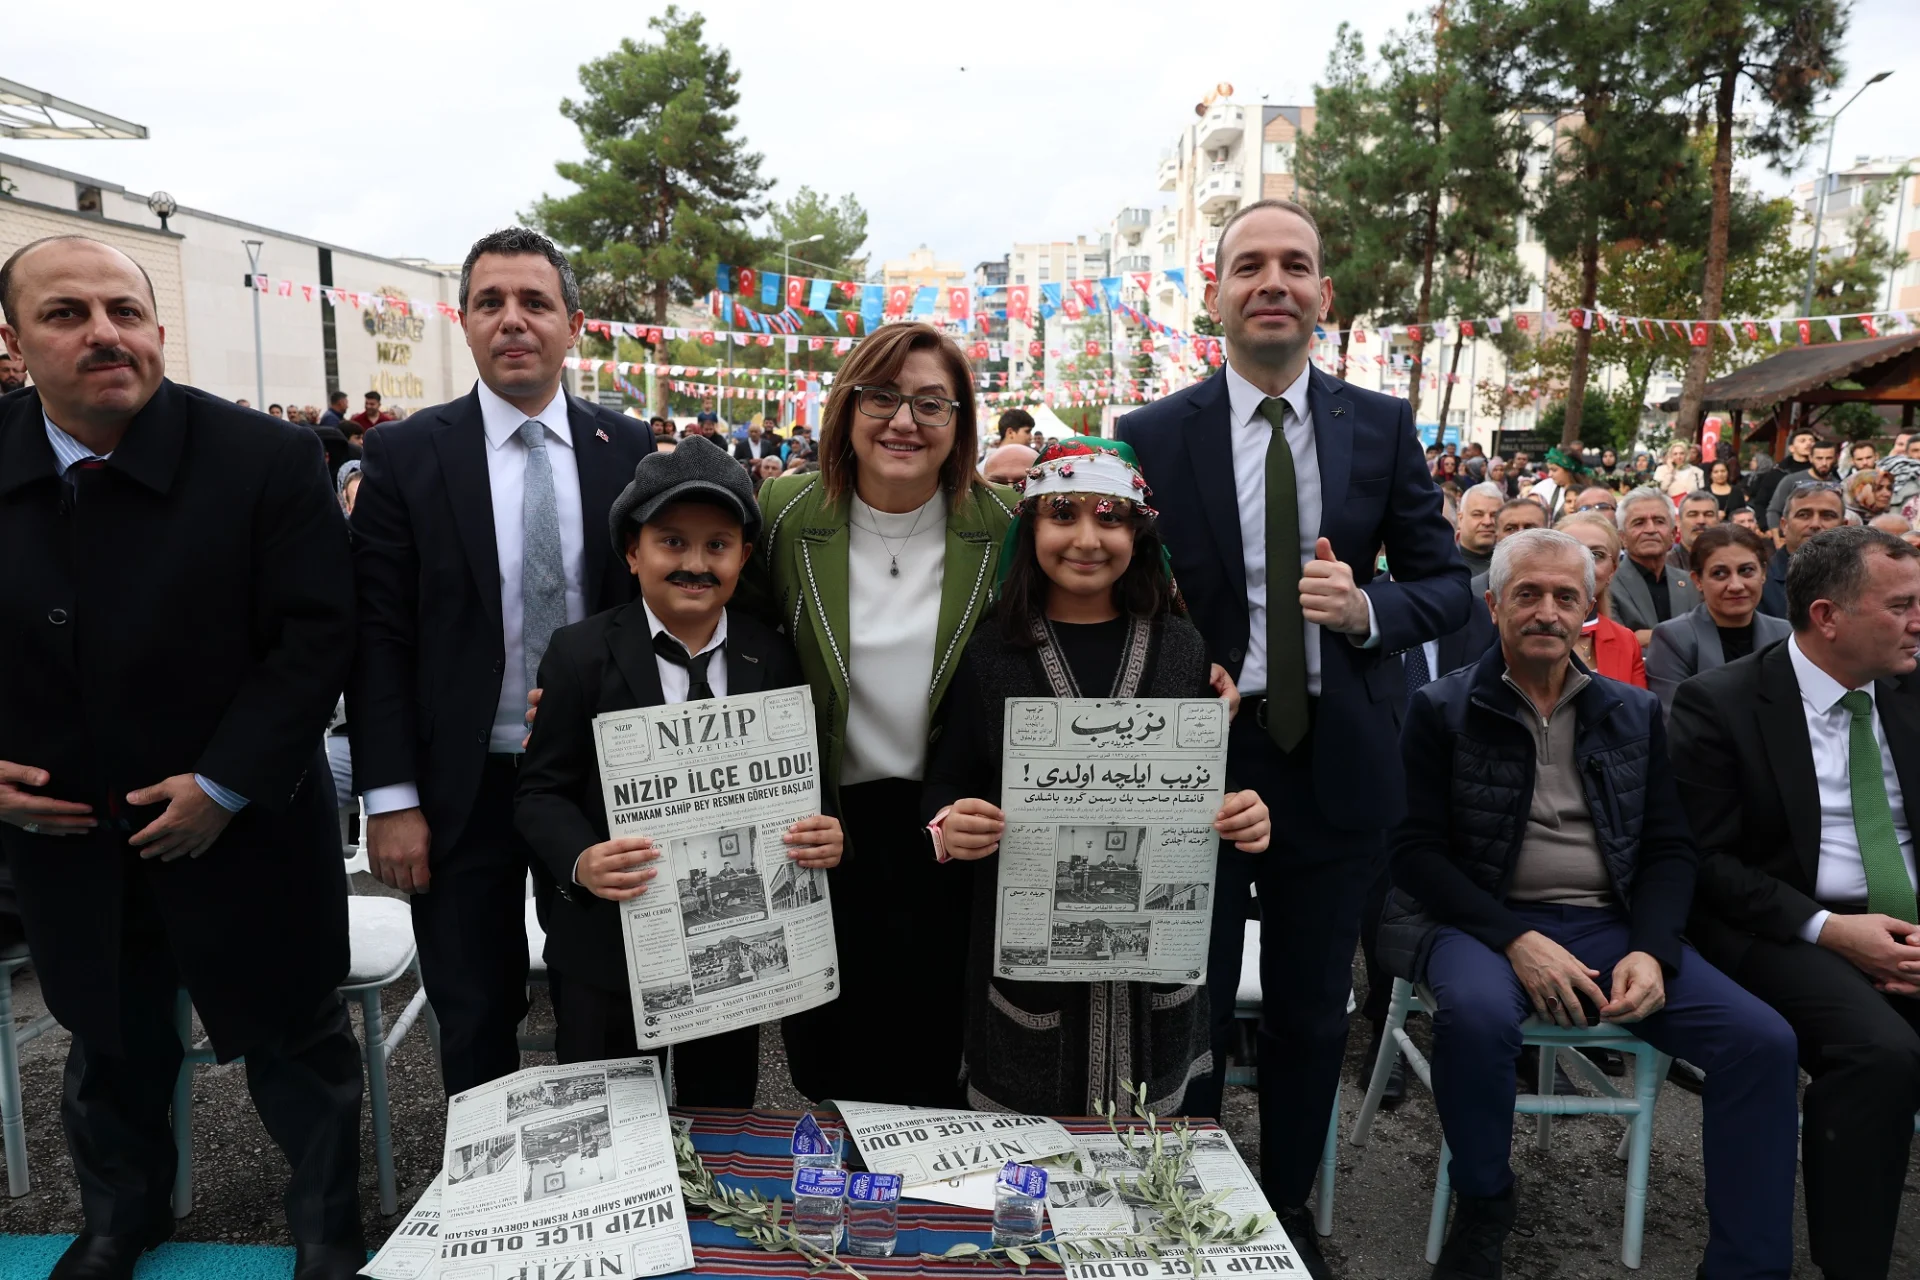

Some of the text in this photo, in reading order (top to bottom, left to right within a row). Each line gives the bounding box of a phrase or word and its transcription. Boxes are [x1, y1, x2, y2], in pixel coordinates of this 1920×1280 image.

[655, 704, 756, 750] NİZİP
[613, 752, 813, 806] NİZİP İLÇE OLDU!
[614, 780, 814, 825] KAYMAKAM SAHİP BEY RESMEN GÖREVE BAŞLADI
[895, 1119, 925, 1129] GÖREVE
[926, 1114, 956, 1124] RESMEN
[856, 1123, 892, 1135] BAŞLADI
[860, 1117, 1047, 1152] NİZİP İLÇE OLDU!
[932, 1140, 1026, 1171] NİZİP
[444, 1183, 673, 1240] KAYMAKAM SAHİP BEY RESMEN GÖREVE BAŞLADI
[398, 1221, 439, 1237] DU!
[441, 1201, 674, 1259] NİZİP İLÇE OLDU!
[1208, 1246, 1236, 1256] SAHİP
[1237, 1243, 1287, 1253] KAYMAKAM
[1070, 1262, 1149, 1279] OLDU!
[1227, 1255, 1294, 1274] NİZİP
